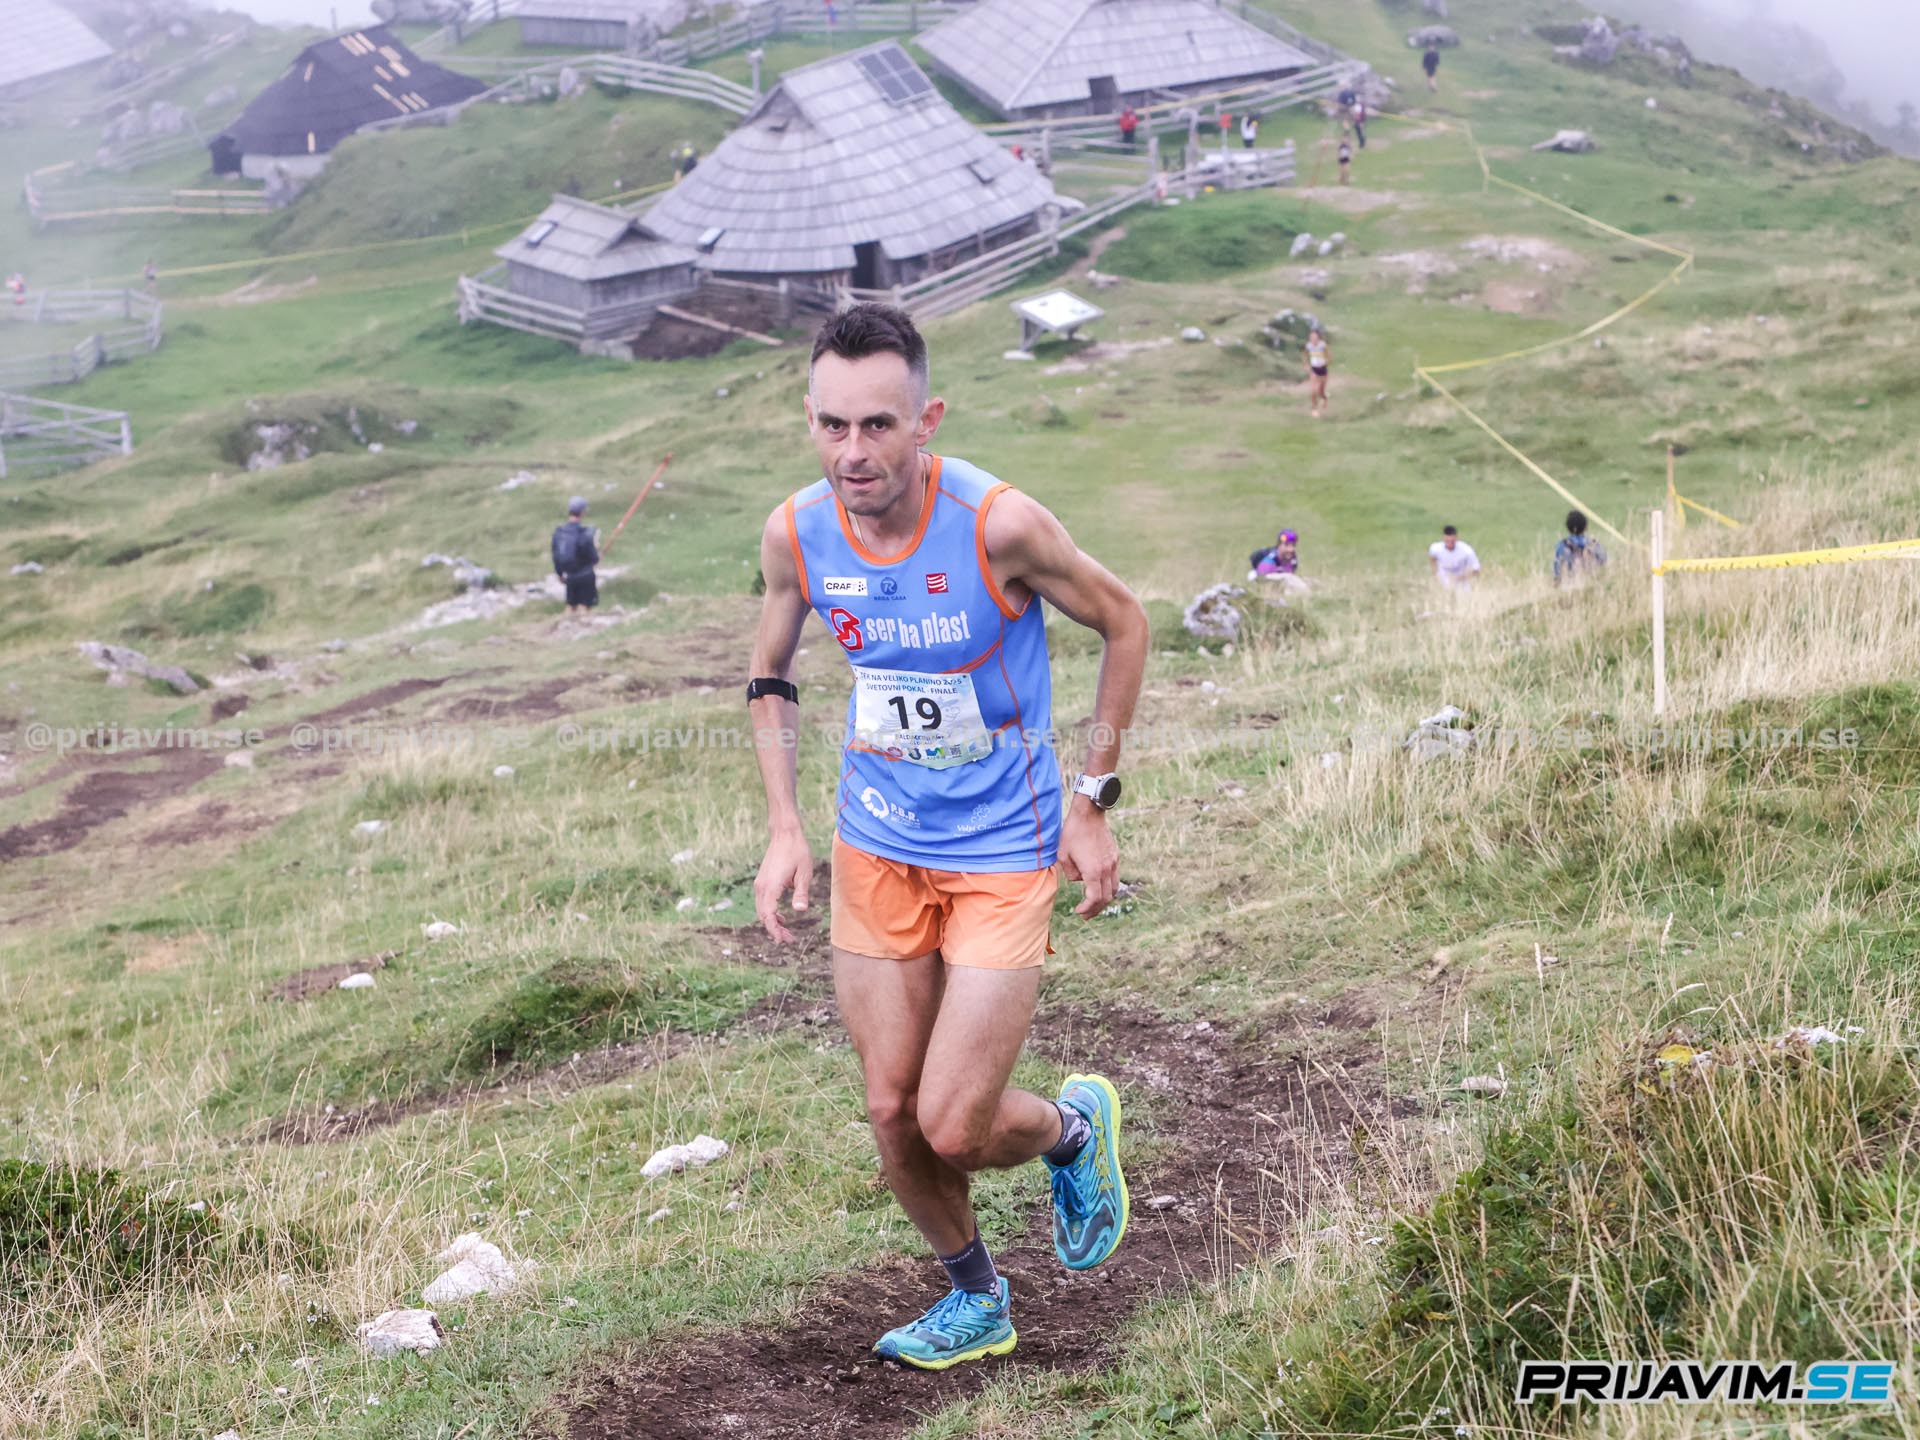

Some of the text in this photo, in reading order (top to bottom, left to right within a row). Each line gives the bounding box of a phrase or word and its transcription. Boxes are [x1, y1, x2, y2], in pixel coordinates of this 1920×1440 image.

[865, 609, 971, 649] ser ba plast
[866, 682, 958, 695] SVETOVNI POKAL FINALE
[871, 674, 882, 682] NA
[882, 674, 909, 683] VELIKO
[909, 676, 942, 686] PLANINO
[888, 696, 942, 731] 19
[890, 803, 920, 822] P.B.R.
